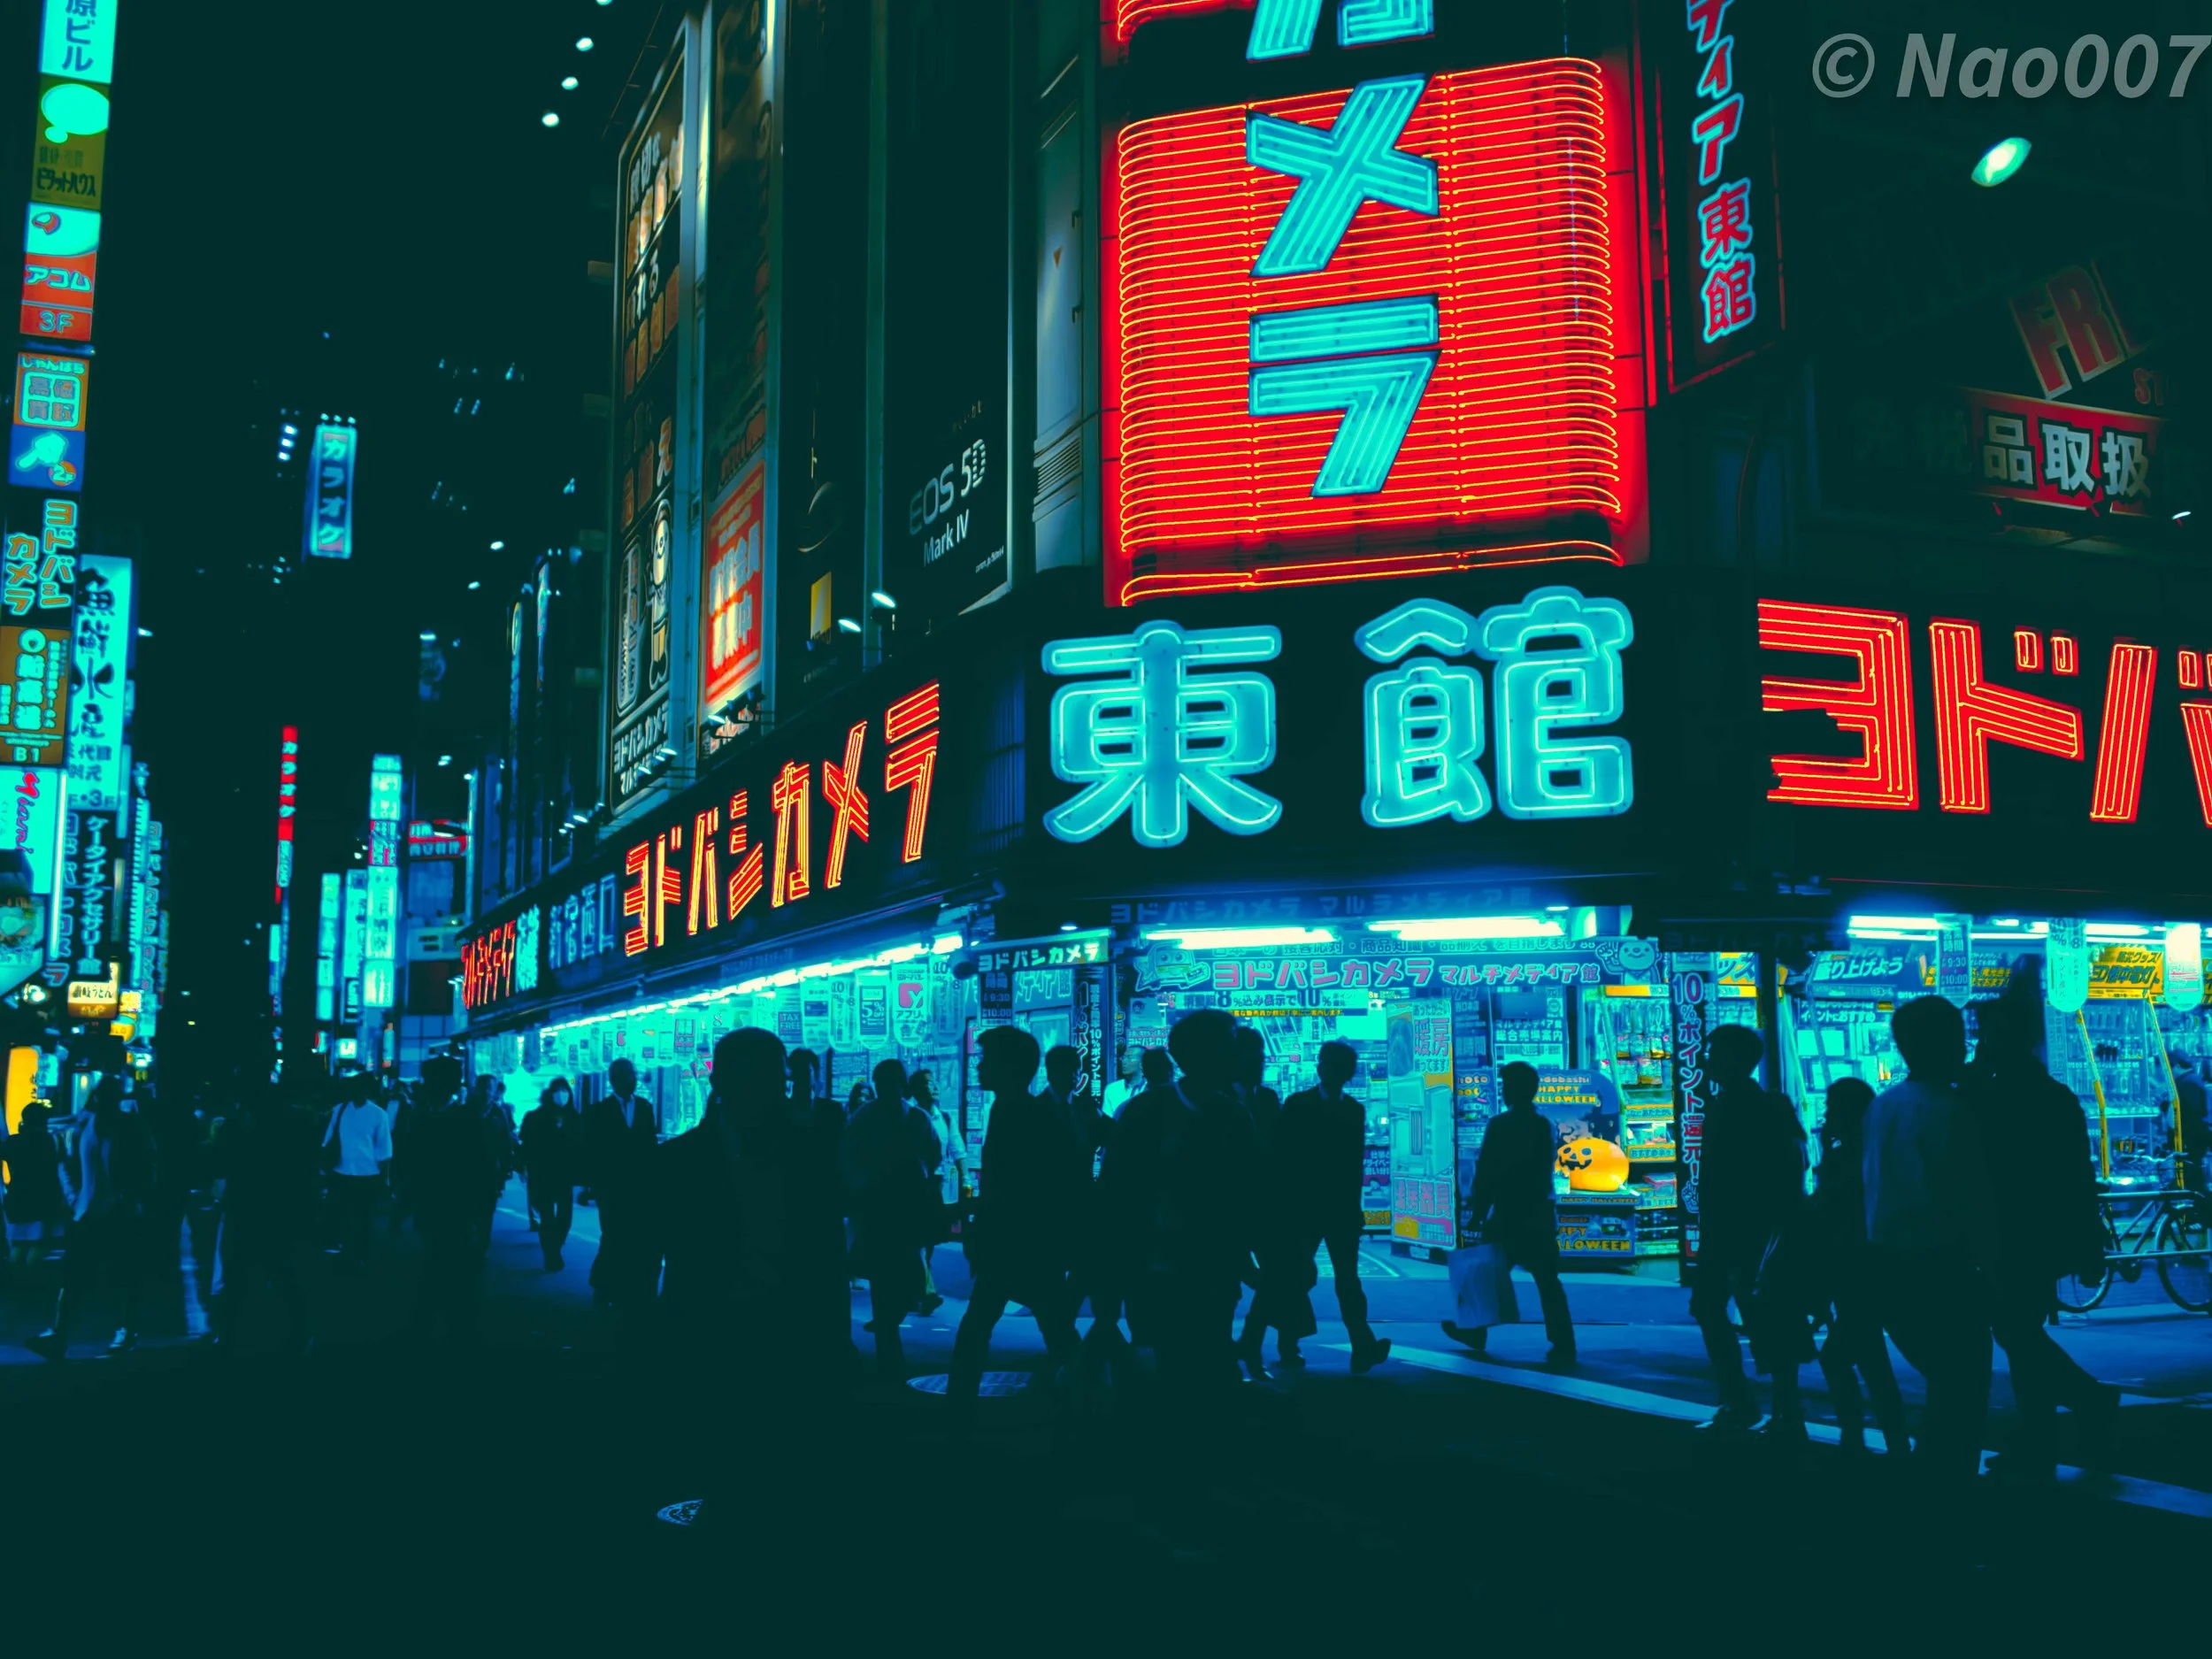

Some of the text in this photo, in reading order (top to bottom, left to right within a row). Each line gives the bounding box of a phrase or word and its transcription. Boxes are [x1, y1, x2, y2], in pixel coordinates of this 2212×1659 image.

[25, 264, 92, 292] アコム
[39, 311, 74, 334] 3F
[910, 438, 987, 535] EOS 5D
[40, 498, 78, 611] ヨドバシ
[924, 508, 971, 568] Mark IV
[4, 533, 40, 616] カメラ
[1042, 586, 1634, 847] 東館
[12, 746, 41, 763] B1
[623, 680, 941, 956] ヨドバシカメラ
[1110, 896, 1302, 924] ヨドバシカメラ
[979, 942, 1100, 972] ヨドバシカメラ
[1212, 956, 1601, 990] ヨドバシカメラ マルチメディア館
[1532, 1094, 1597, 1104] ALLOWEEN
